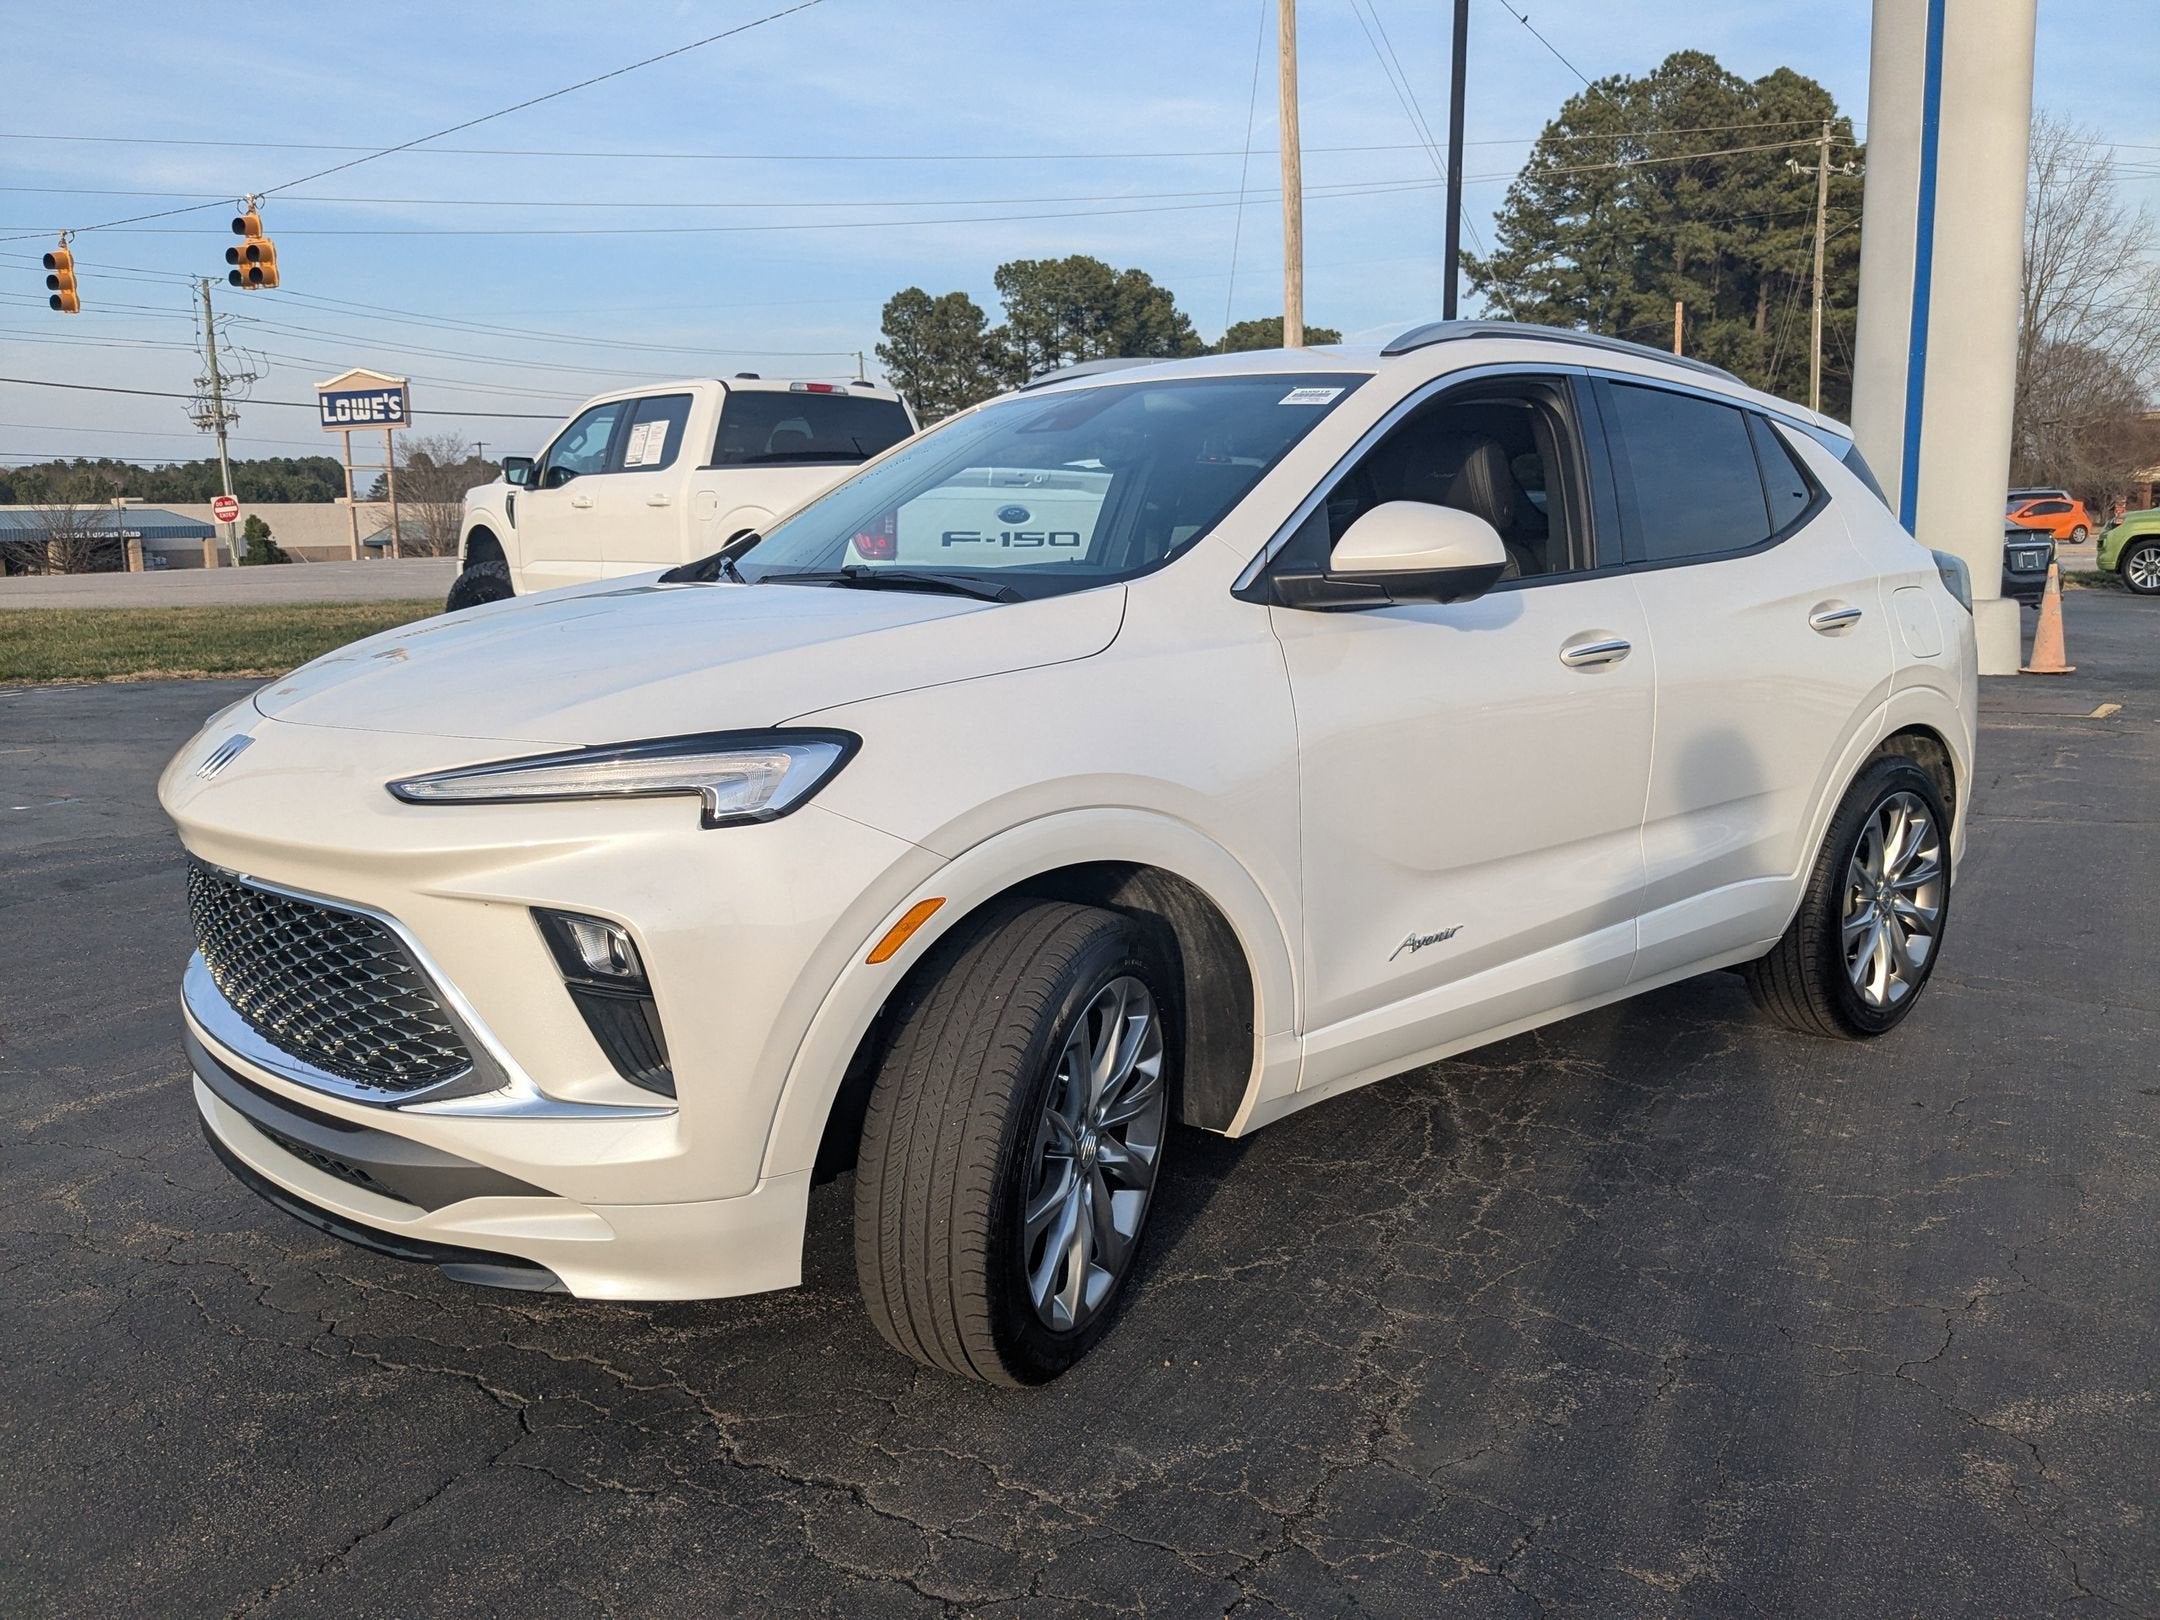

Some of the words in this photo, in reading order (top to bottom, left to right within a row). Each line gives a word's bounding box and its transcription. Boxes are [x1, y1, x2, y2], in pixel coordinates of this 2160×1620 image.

[322, 393, 401, 422] LOWE'S
[942, 531, 1080, 547] F-150
[1388, 924, 1464, 962] Avenir
